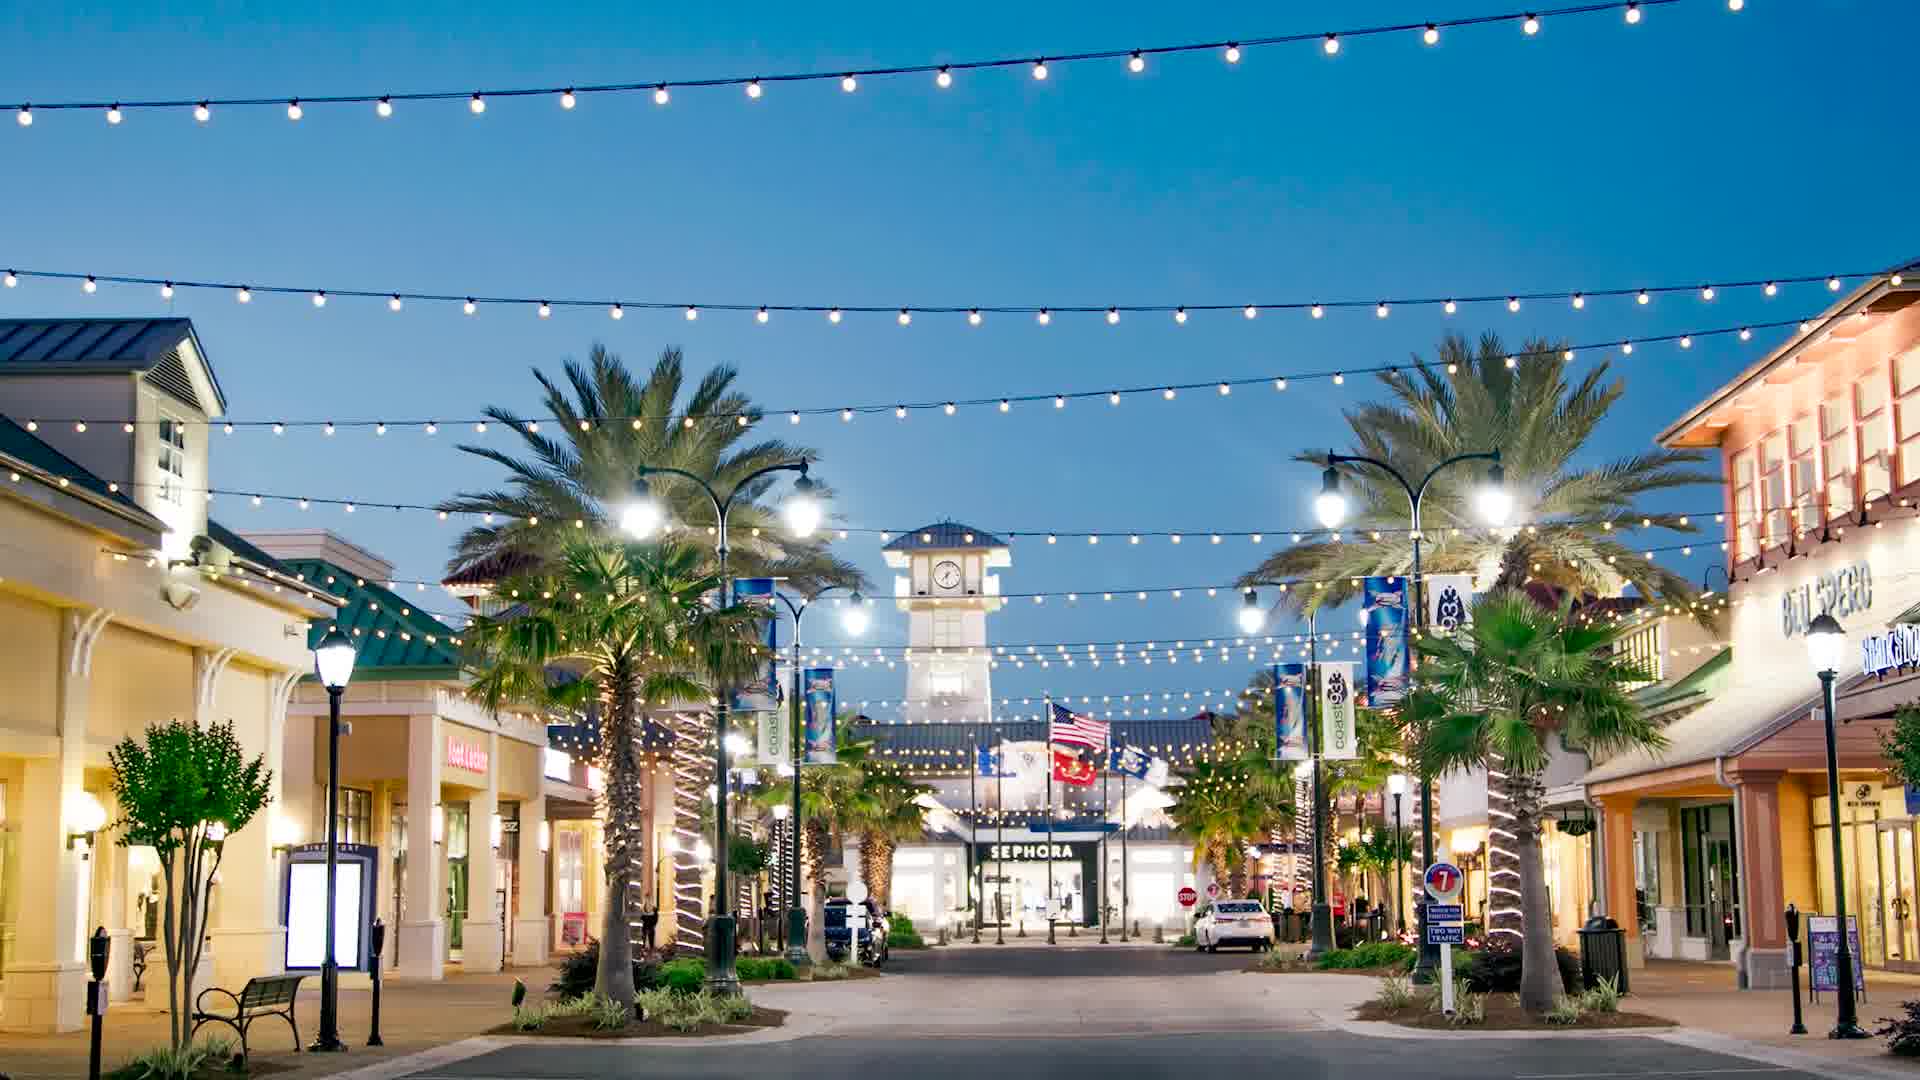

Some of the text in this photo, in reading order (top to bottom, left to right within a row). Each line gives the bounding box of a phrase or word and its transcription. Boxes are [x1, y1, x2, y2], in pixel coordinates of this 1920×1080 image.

[991, 845, 1073, 859] SEPHORA
[1438, 871, 1448, 890] 7
[1180, 892, 1197, 901] STOP
